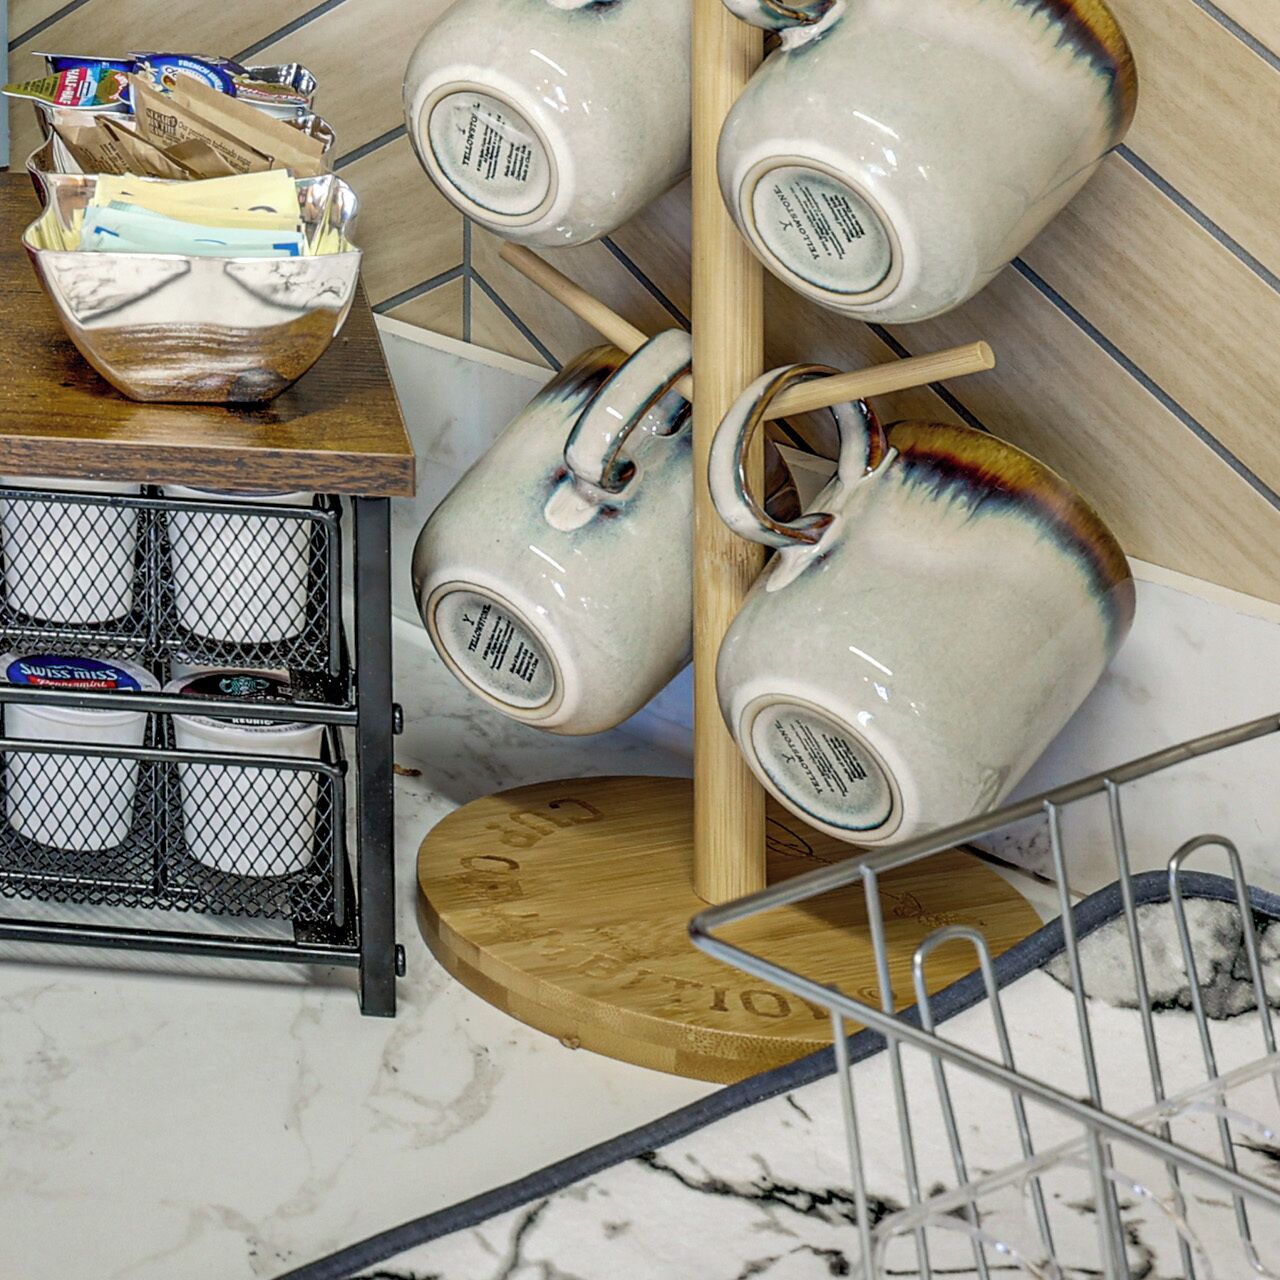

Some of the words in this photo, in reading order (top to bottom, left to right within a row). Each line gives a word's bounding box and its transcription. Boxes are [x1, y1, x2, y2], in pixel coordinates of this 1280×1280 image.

[64, 68, 79, 88] HALF
[178, 59, 209, 75] FRENCH
[462, 103, 481, 166] YELLOWSTO
[773, 185, 820, 260] YELLOWSTONE
[468, 604, 492, 652] YELLOWSTONE
[20, 663, 71, 679] SWISS
[74, 668, 117, 681] MISS
[774, 720, 823, 794] YELLOWSTONE
[485, 797, 605, 848] CUP
